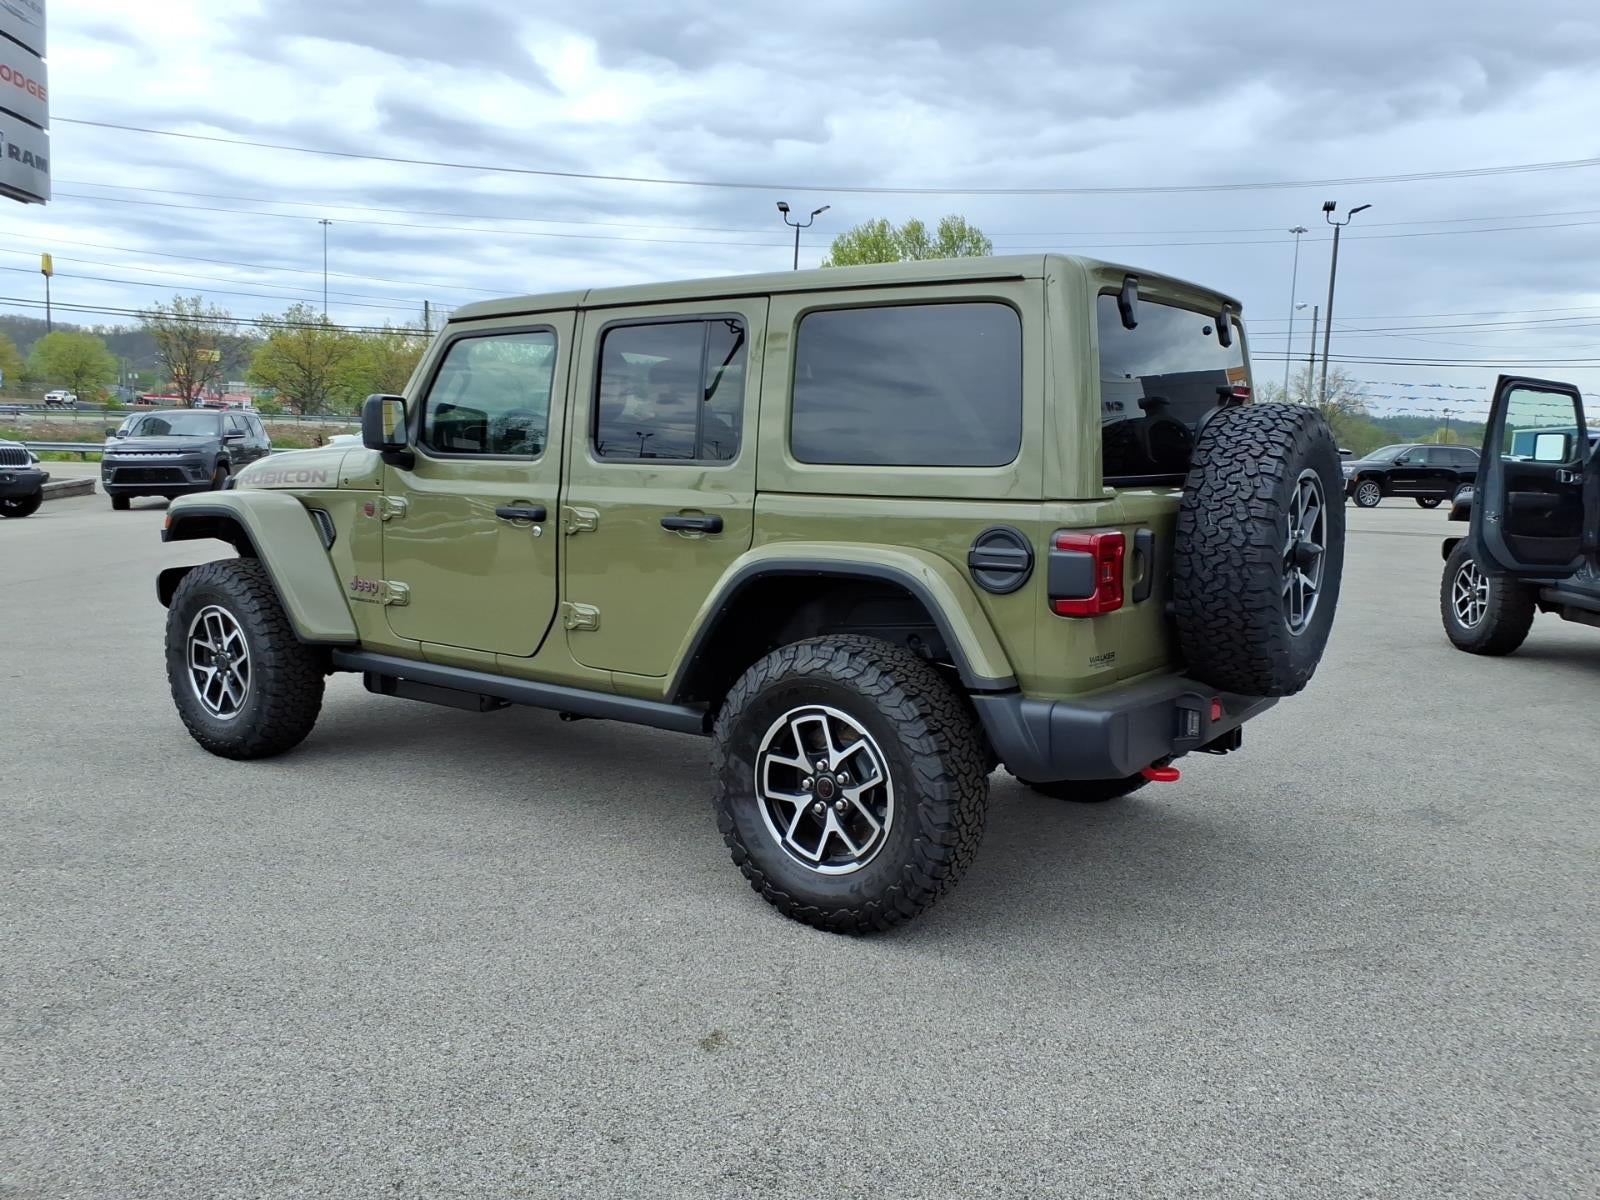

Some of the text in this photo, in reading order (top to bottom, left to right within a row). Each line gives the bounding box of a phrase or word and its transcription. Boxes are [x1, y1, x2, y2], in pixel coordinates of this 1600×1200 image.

[0, 64, 47, 102] ODGE
[8, 142, 48, 174] RAM
[239, 470, 328, 485] RUBICON
[350, 576, 379, 596] Jeep
